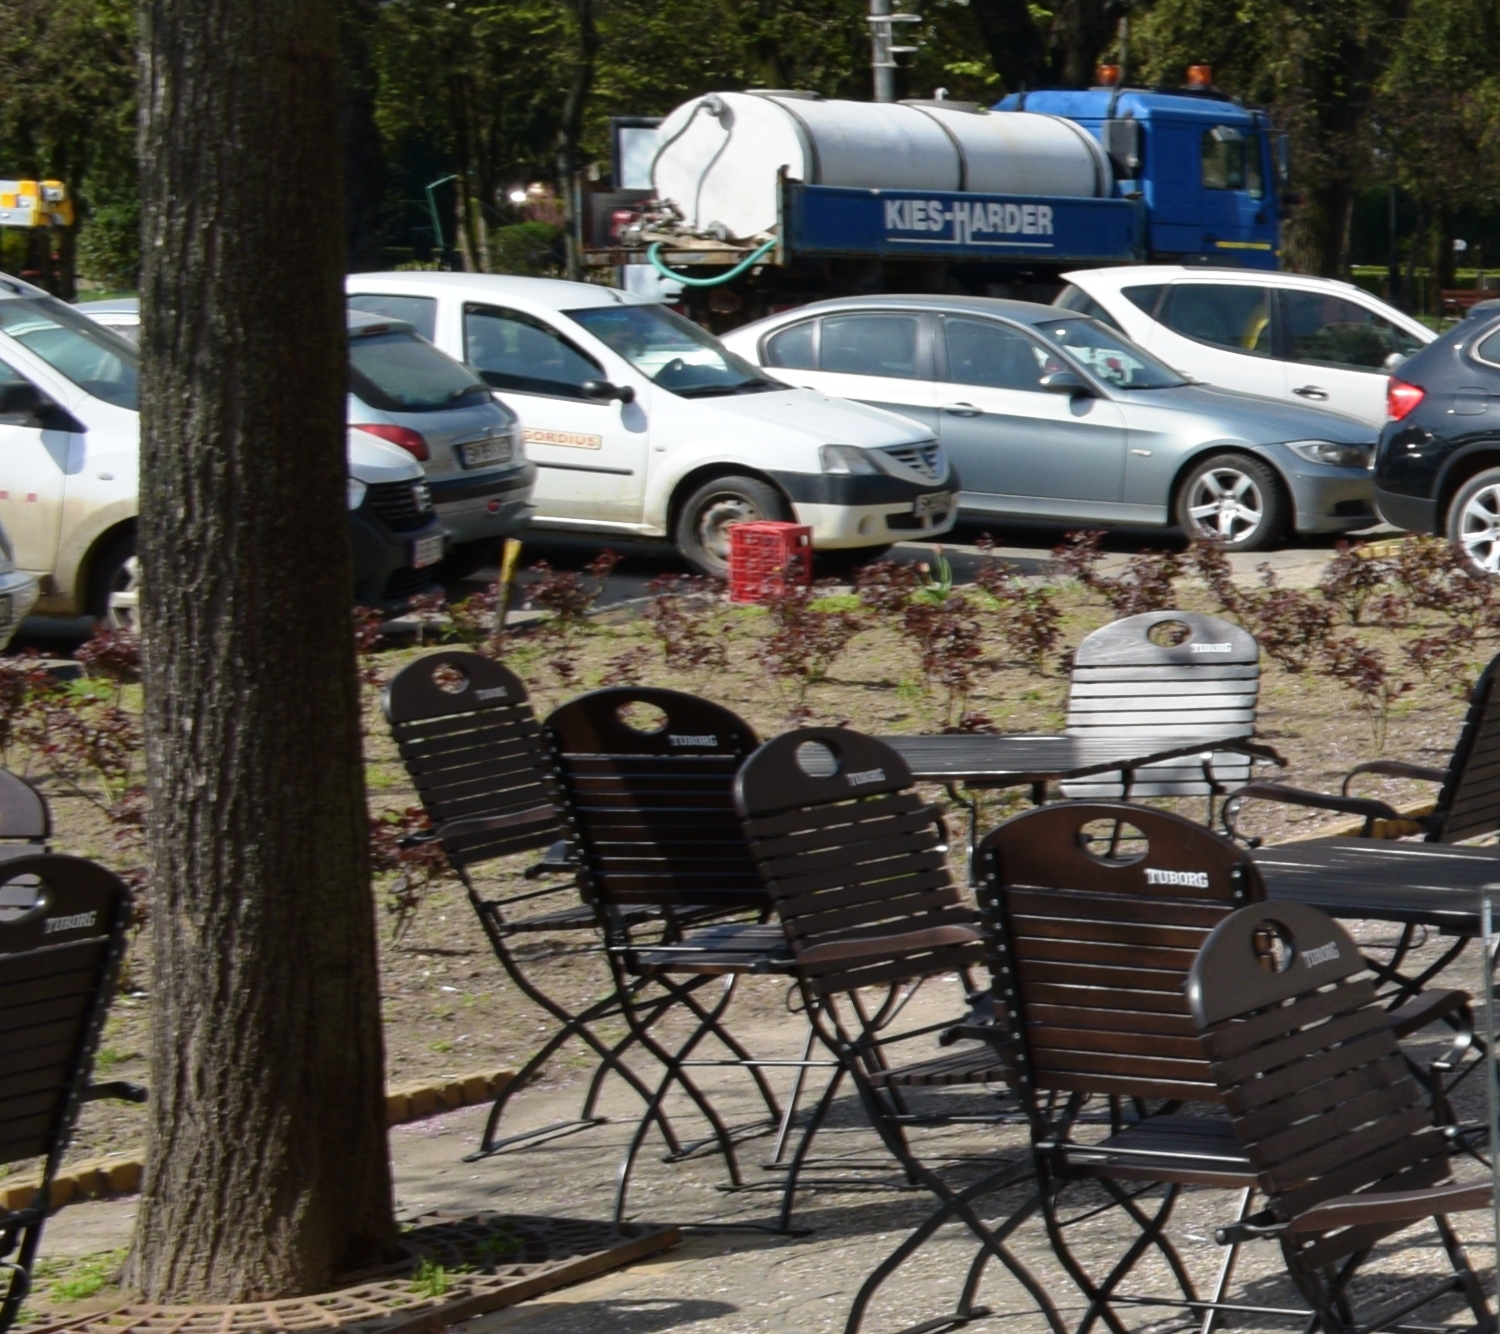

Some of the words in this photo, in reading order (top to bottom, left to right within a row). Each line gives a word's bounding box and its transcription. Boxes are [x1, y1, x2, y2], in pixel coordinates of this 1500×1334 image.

[884, 200, 1053, 243] KIES-HARDER
[523, 429, 597, 447] GORDIUS
[1144, 868, 1209, 888] TUBORG
